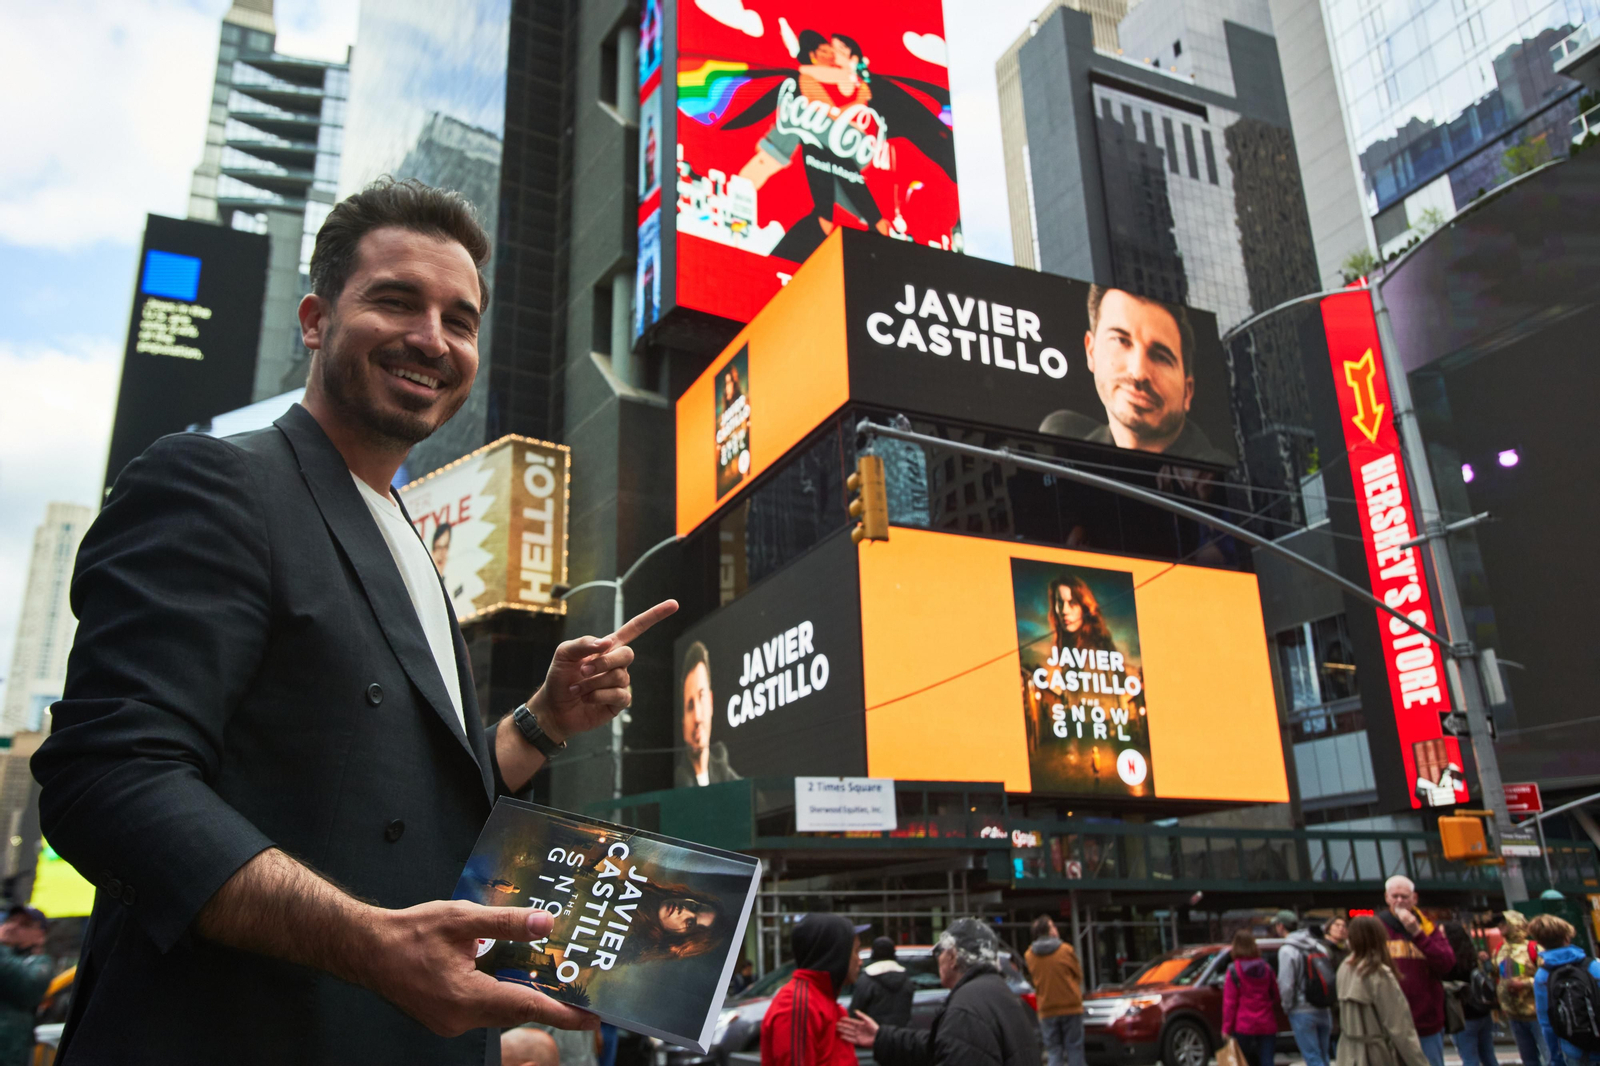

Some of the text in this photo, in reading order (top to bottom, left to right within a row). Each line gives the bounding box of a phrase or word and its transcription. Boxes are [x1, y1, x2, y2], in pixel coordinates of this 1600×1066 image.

[776, 77, 892, 170] Coca-Cola
[894, 284, 1042, 342] JAVIER
[866, 312, 1068, 379] CASTILLO
[412, 495, 472, 541] TYLE
[519, 452, 556, 604] HELLO!
[1361, 453, 1441, 709] HERSHEY'S STORE
[739, 620, 814, 687] JAVIER
[1033, 667, 1141, 696] CASTILLO
[1047, 645, 1125, 672] JAVIER
[727, 653, 829, 728] CASTILLO
[1051, 703, 1129, 725] SNOW
[1053, 721, 1131, 741] GIRL
[808, 782, 882, 794] 2 Times Square
[556, 842, 630, 983] CASTILLO
[563, 893, 579, 916] THE
[590, 865, 648, 971] JAVIER
